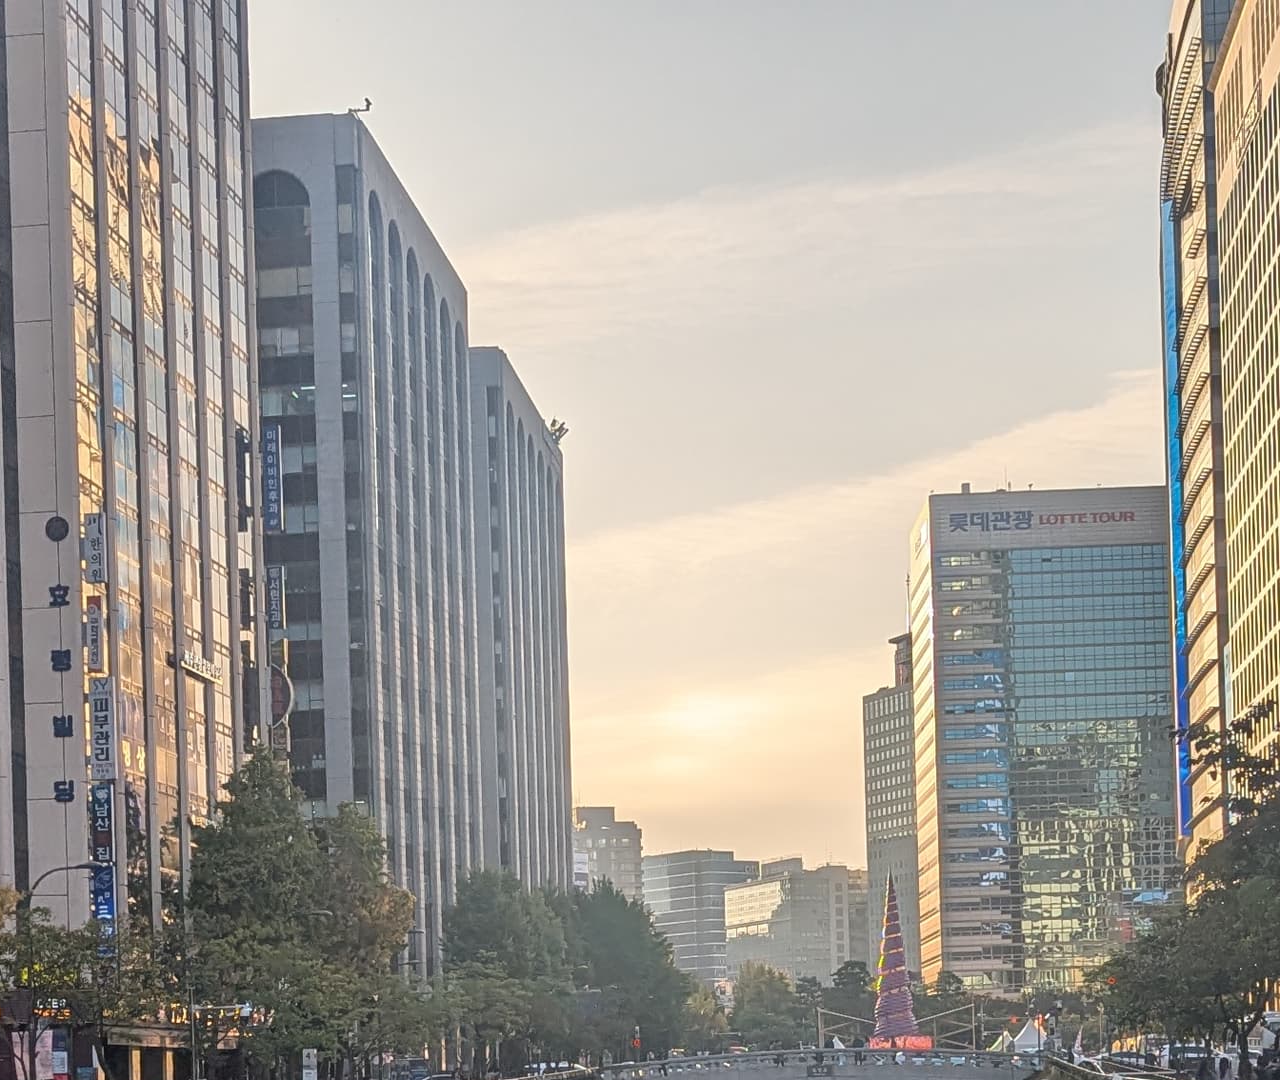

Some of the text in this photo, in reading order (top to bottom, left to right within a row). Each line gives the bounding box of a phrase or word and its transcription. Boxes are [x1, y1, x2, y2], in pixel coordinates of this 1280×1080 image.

[949, 510, 1136, 532] 롯데관광 LOTTE TOUR
[90, 536, 102, 582] 한의원
[93, 697, 110, 762] 피부관리
